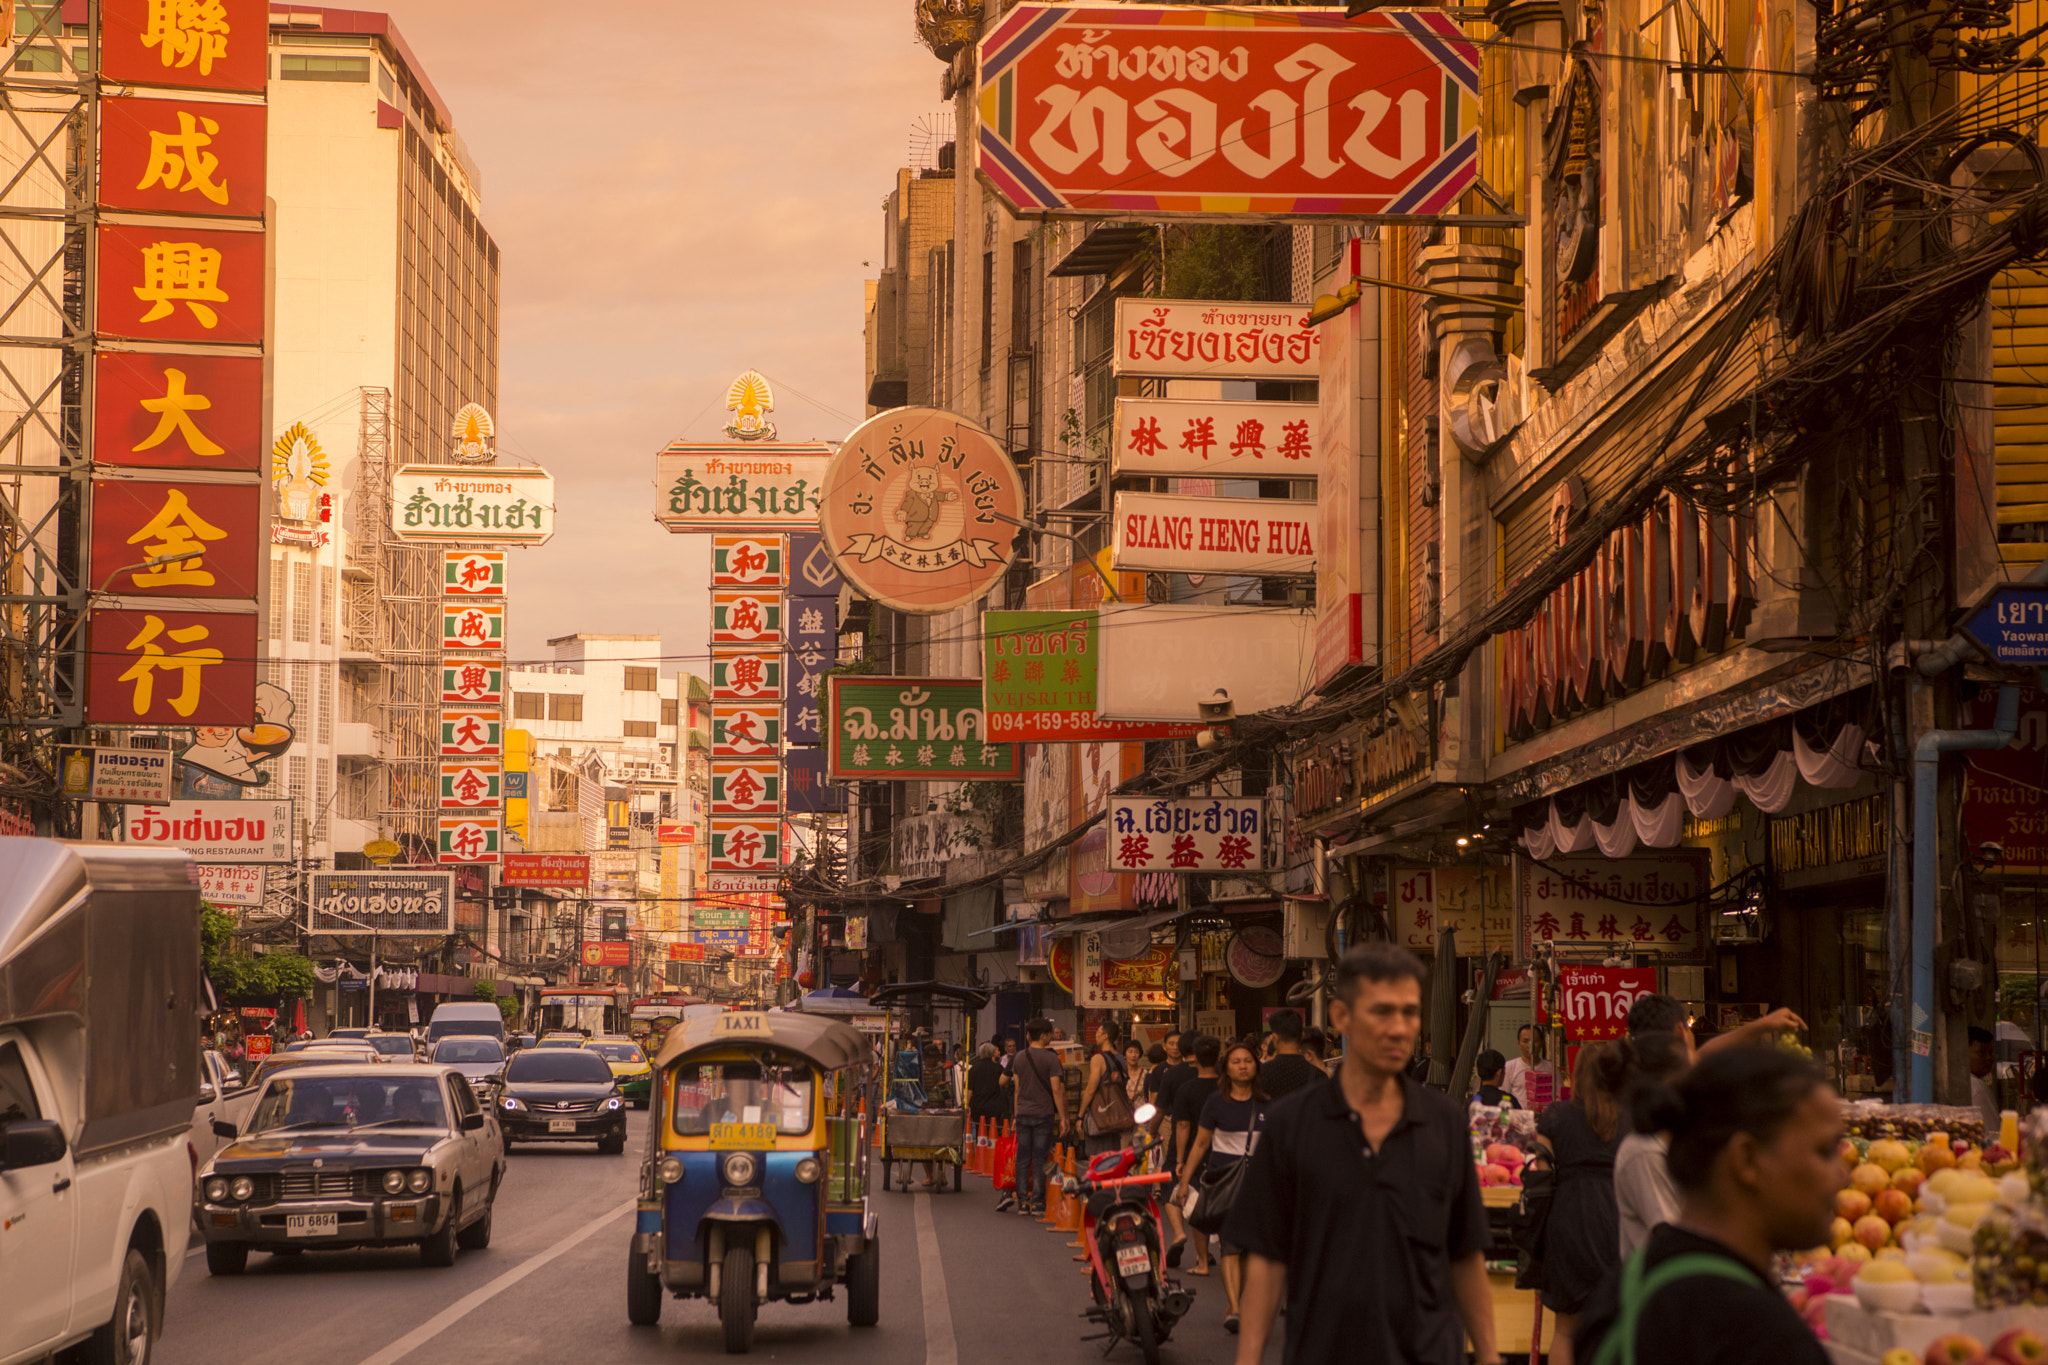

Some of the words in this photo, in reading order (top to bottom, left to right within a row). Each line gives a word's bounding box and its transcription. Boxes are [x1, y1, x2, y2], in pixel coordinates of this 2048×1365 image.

[1055, 28, 1249, 82] ห้างทอง
[1202, 308, 1292, 326] ห้างขายยา
[1128, 308, 1320, 364] เซี้ยงเฮงฮั
[1128, 416, 1313, 460] 林祥興藥
[705, 458, 792, 474] ห้างขายทอง
[434, 478, 512, 493] ห้างขายทอง
[404, 487, 543, 529] ฮั่วเซ่งเฮง
[1126, 513, 1193, 551] SIANG
[1200, 517, 1261, 555] HENG
[1267, 520, 1313, 556] HUA
[1998, 602, 2048, 624] เยา
[995, 619, 1088, 655] เวชศรี
[992, 659, 1098, 687] 華聯藥
[453, 560, 490, 858] 和成興大金行
[726, 544, 767, 864] 和成興大金行
[993, 692, 1058, 708] VEJSRI
[98, 754, 164, 770] แสงอรุณ
[852, 744, 1000, 768] 蔡永發藥行
[1116, 834, 1255, 869] 蔡益發
[319, 888, 442, 914] เซ่งเฮงหลี
[1566, 972, 1605, 986] เจ้าเก่า
[723, 1016, 760, 1030] TAXI
[739, 1126, 773, 1139] 4189
[309, 1215, 336, 1226] 6894
